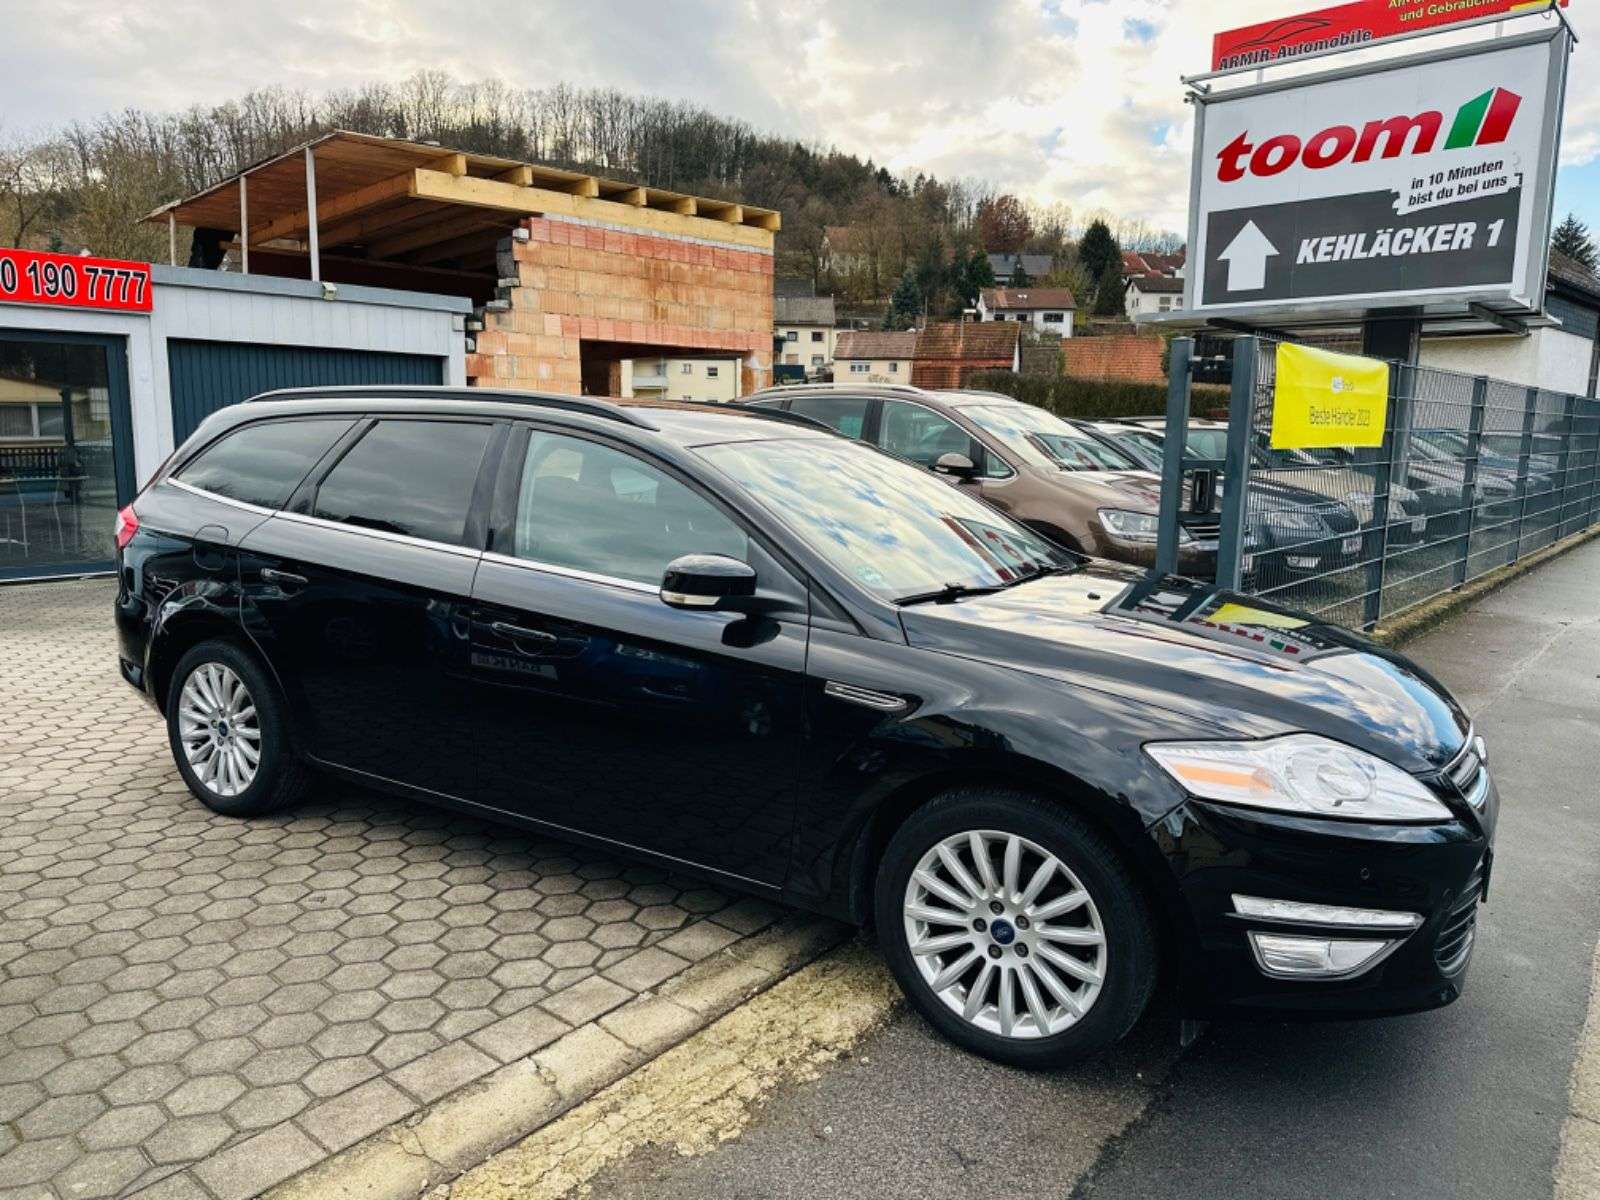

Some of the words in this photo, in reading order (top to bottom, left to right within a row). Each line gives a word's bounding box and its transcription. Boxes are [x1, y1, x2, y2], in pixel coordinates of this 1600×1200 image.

[1400, 8, 1424, 21] und
[1216, 110, 1443, 183] toom
[1408, 190, 1433, 207] bist
[1436, 187, 1453, 201] du
[1457, 180, 1478, 196] bei
[1482, 176, 1507, 190] uns
[1411, 177, 1424, 190] in
[1429, 172, 1444, 186] 10
[1447, 160, 1504, 182] Minuten
[1296, 221, 1477, 264] KEHLÄCKER
[1487, 218, 1505, 248] 1
[26, 259, 78, 299] 190
[83, 265, 148, 304] 7777
